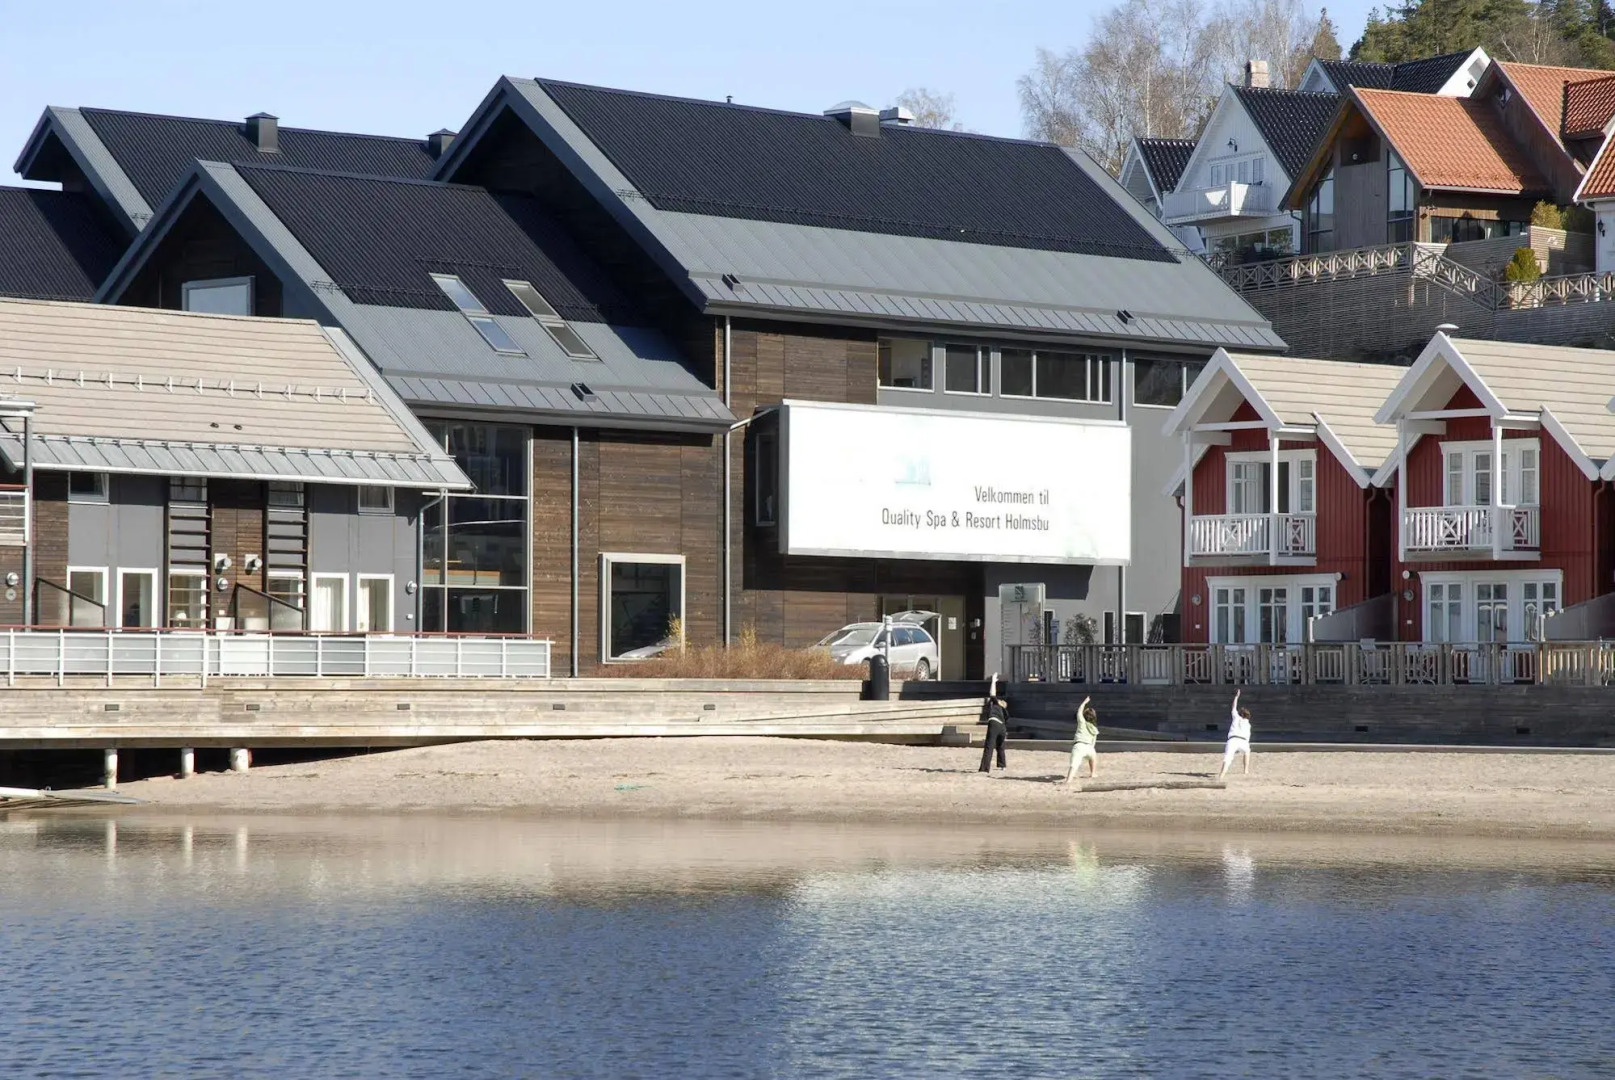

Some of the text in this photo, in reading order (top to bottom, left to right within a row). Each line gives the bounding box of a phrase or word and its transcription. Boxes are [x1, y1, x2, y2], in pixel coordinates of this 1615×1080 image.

[974, 485, 1049, 505] Velkommen til
[881, 507, 1049, 531] Quality Spa & Resort Holmsbu
